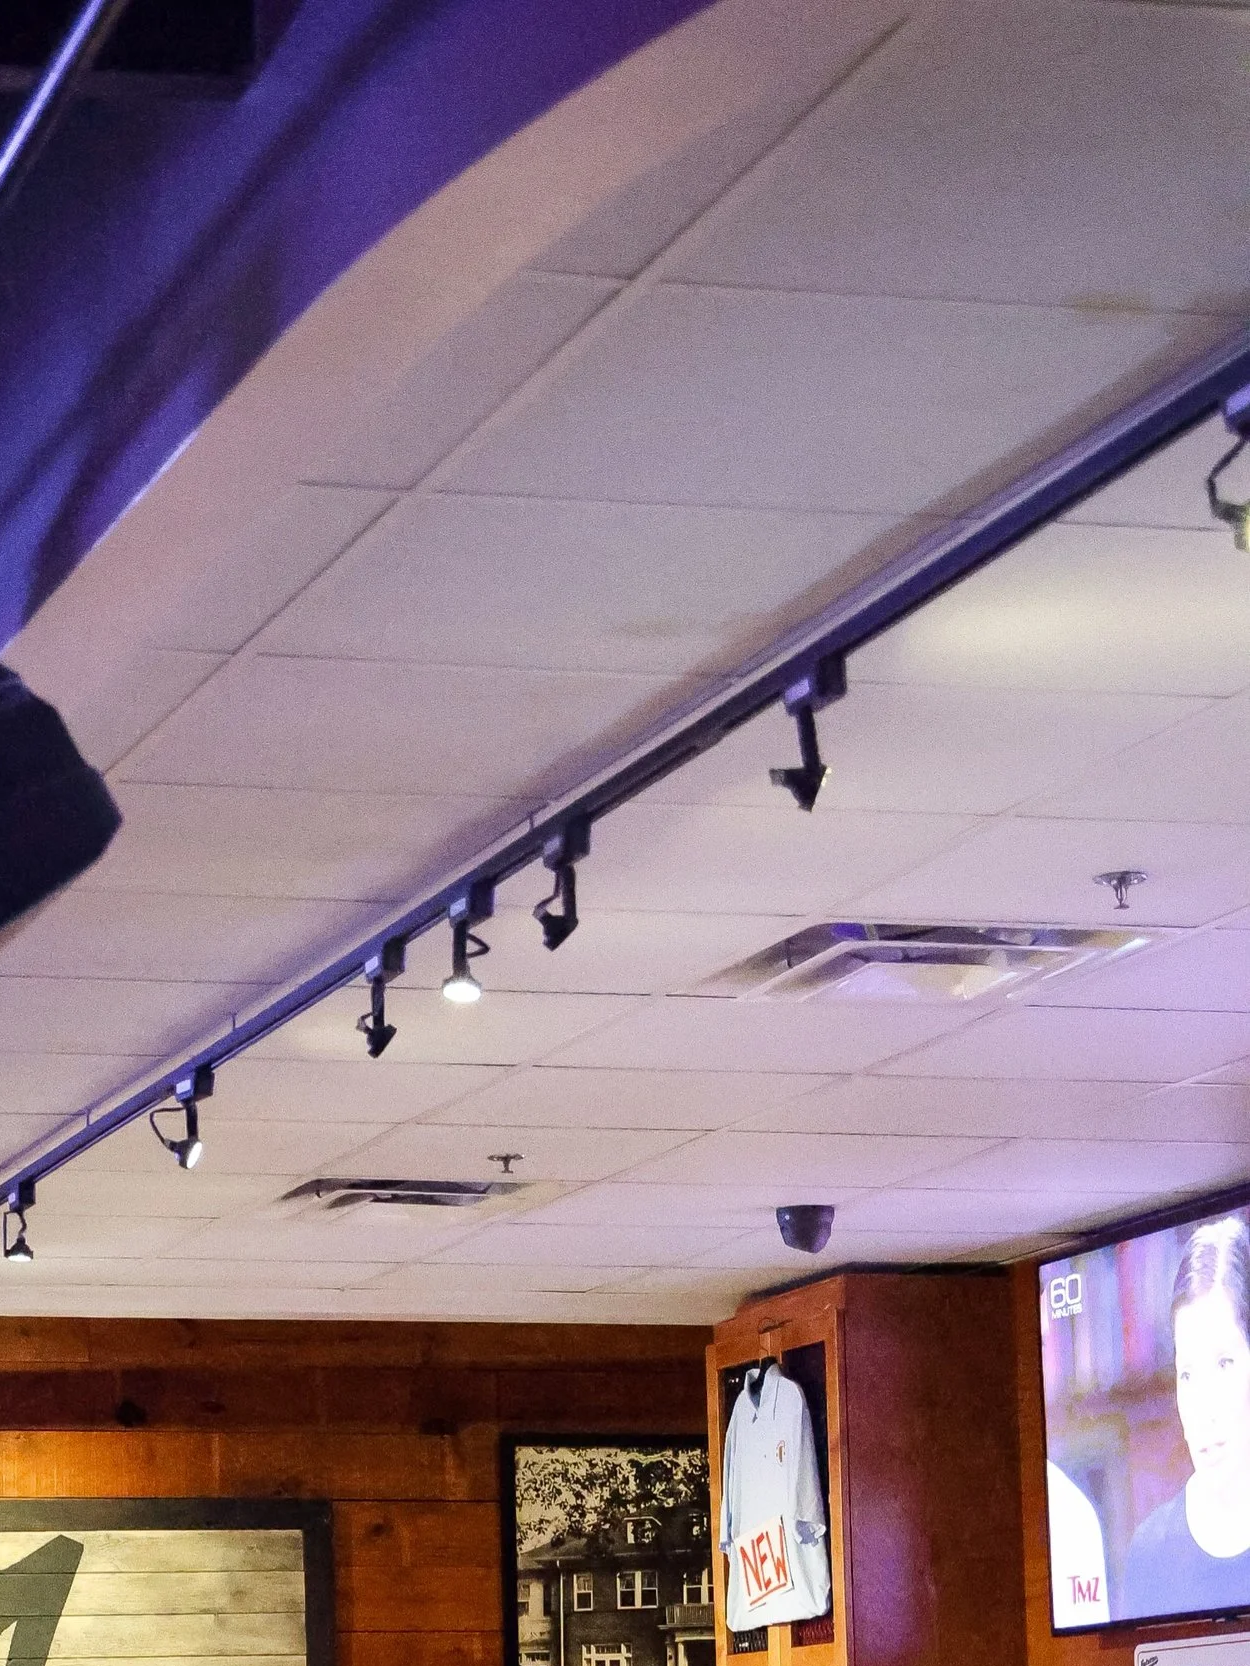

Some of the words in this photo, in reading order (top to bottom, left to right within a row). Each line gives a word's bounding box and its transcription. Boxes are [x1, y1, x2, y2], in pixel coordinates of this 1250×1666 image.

[1050, 1273, 1082, 1309] 60
[1052, 1303, 1083, 1319] MINUTES
[739, 1524, 788, 1597] NEW
[1067, 1575, 1101, 1605] TMZ
